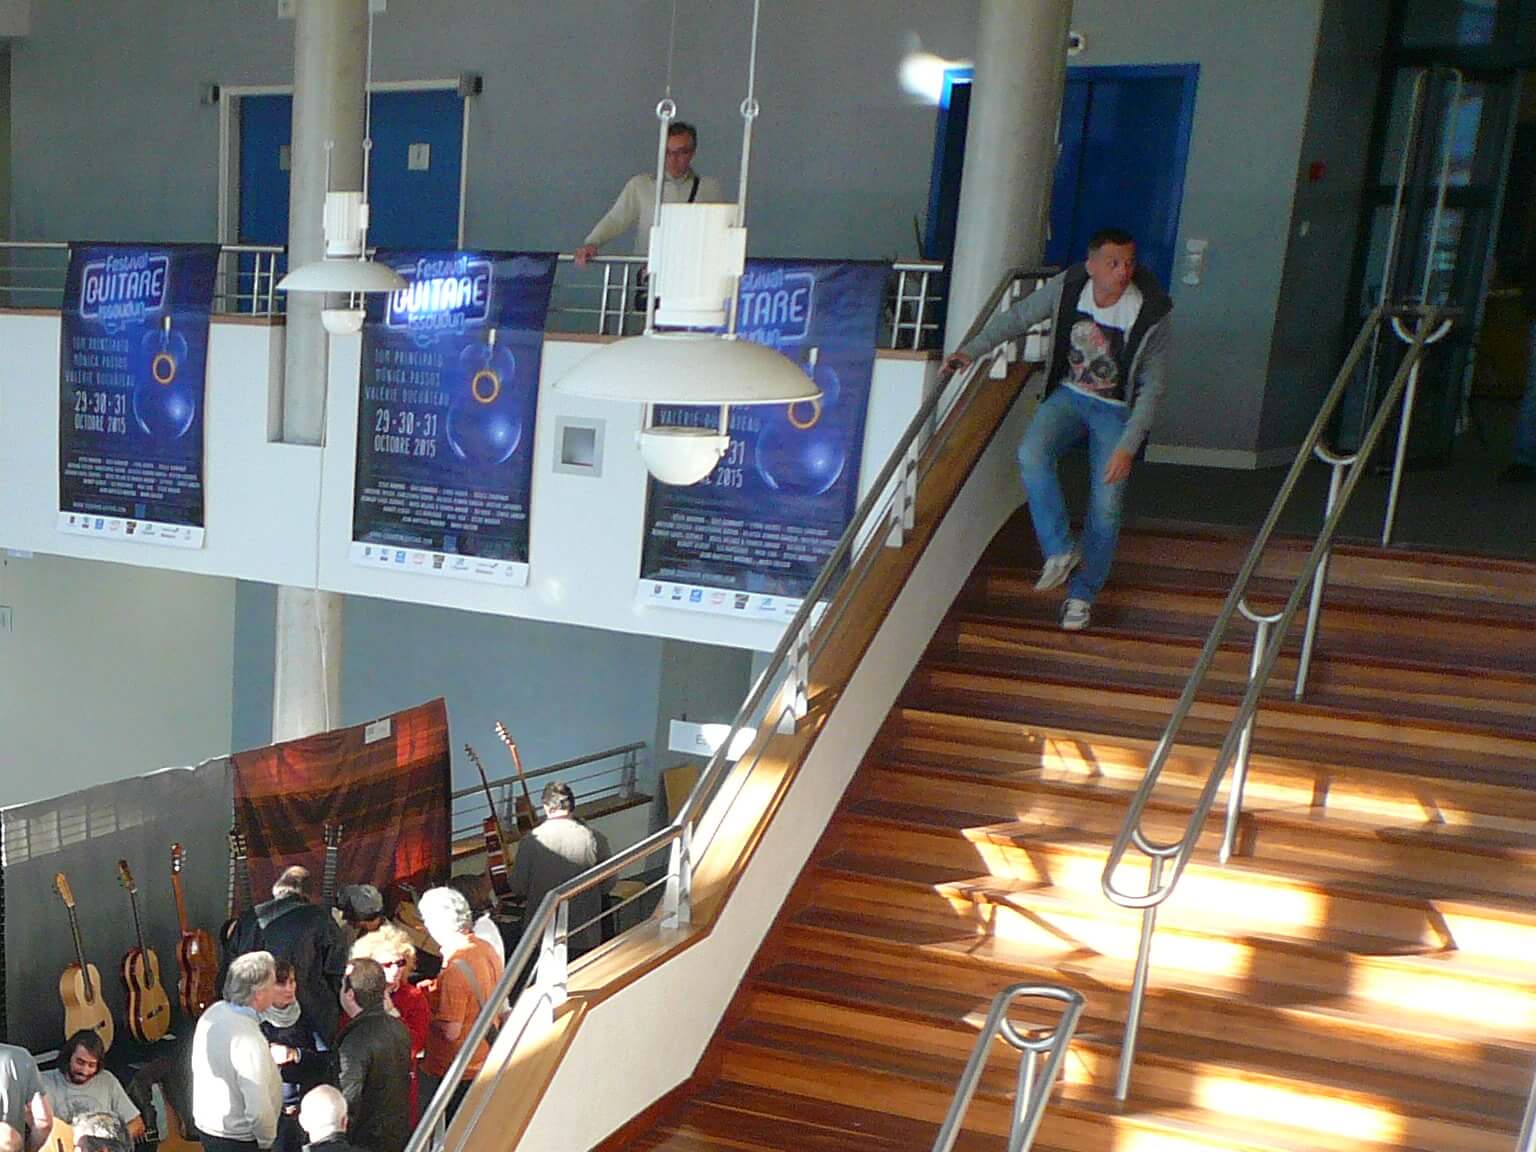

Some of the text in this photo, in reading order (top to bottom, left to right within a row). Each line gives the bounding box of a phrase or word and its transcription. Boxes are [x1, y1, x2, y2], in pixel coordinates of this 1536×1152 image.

[86, 268, 164, 304] GUITARE
[107, 416, 126, 435] 2015
[374, 434, 436, 457] OCTOBRE 2015
